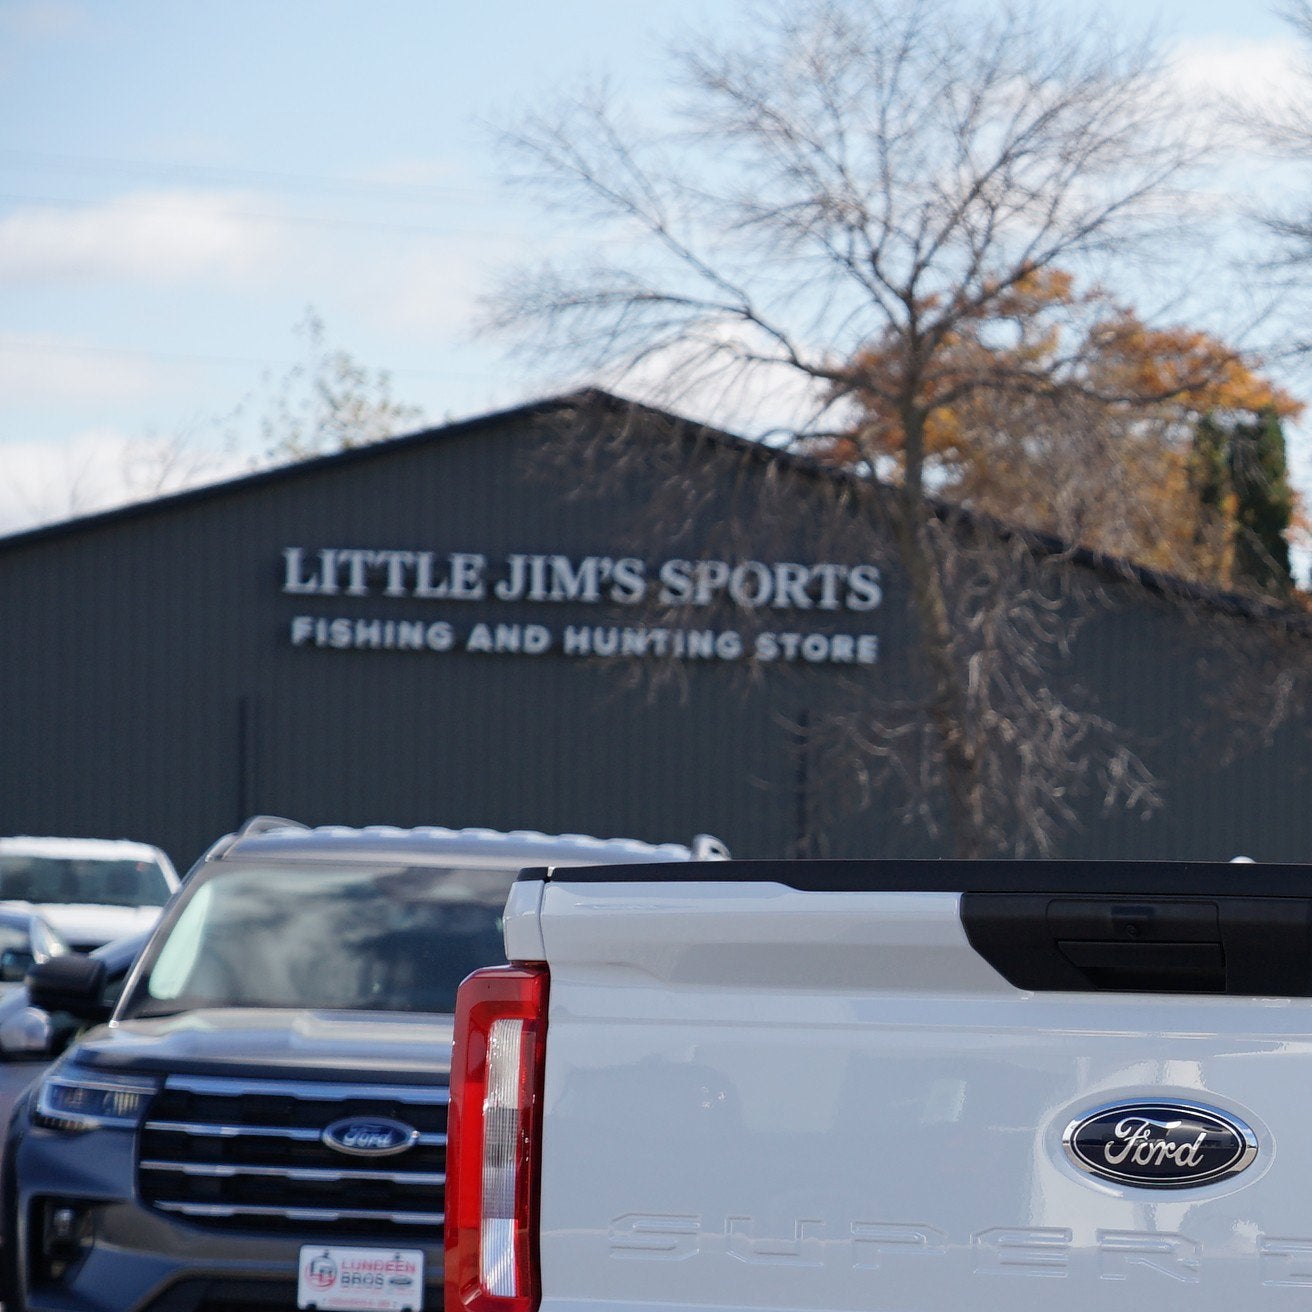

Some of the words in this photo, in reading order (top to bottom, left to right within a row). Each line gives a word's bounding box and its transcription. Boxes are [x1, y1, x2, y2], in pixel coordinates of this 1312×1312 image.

[282, 547, 487, 600] LITTLE
[495, 553, 646, 604] JIM'S
[659, 558, 883, 611] SPORTS
[291, 615, 453, 651] FISHING
[466, 622, 549, 654] AND
[563, 625, 743, 660] HUNTING
[754, 632, 880, 664] STORE
[342, 1123, 393, 1148] Ford
[1104, 1116, 1207, 1168] Ford
[341, 1259, 416, 1275] LUNDEEN
[609, 1212, 1200, 1283] SUPER
[341, 1272, 385, 1286] BROS
